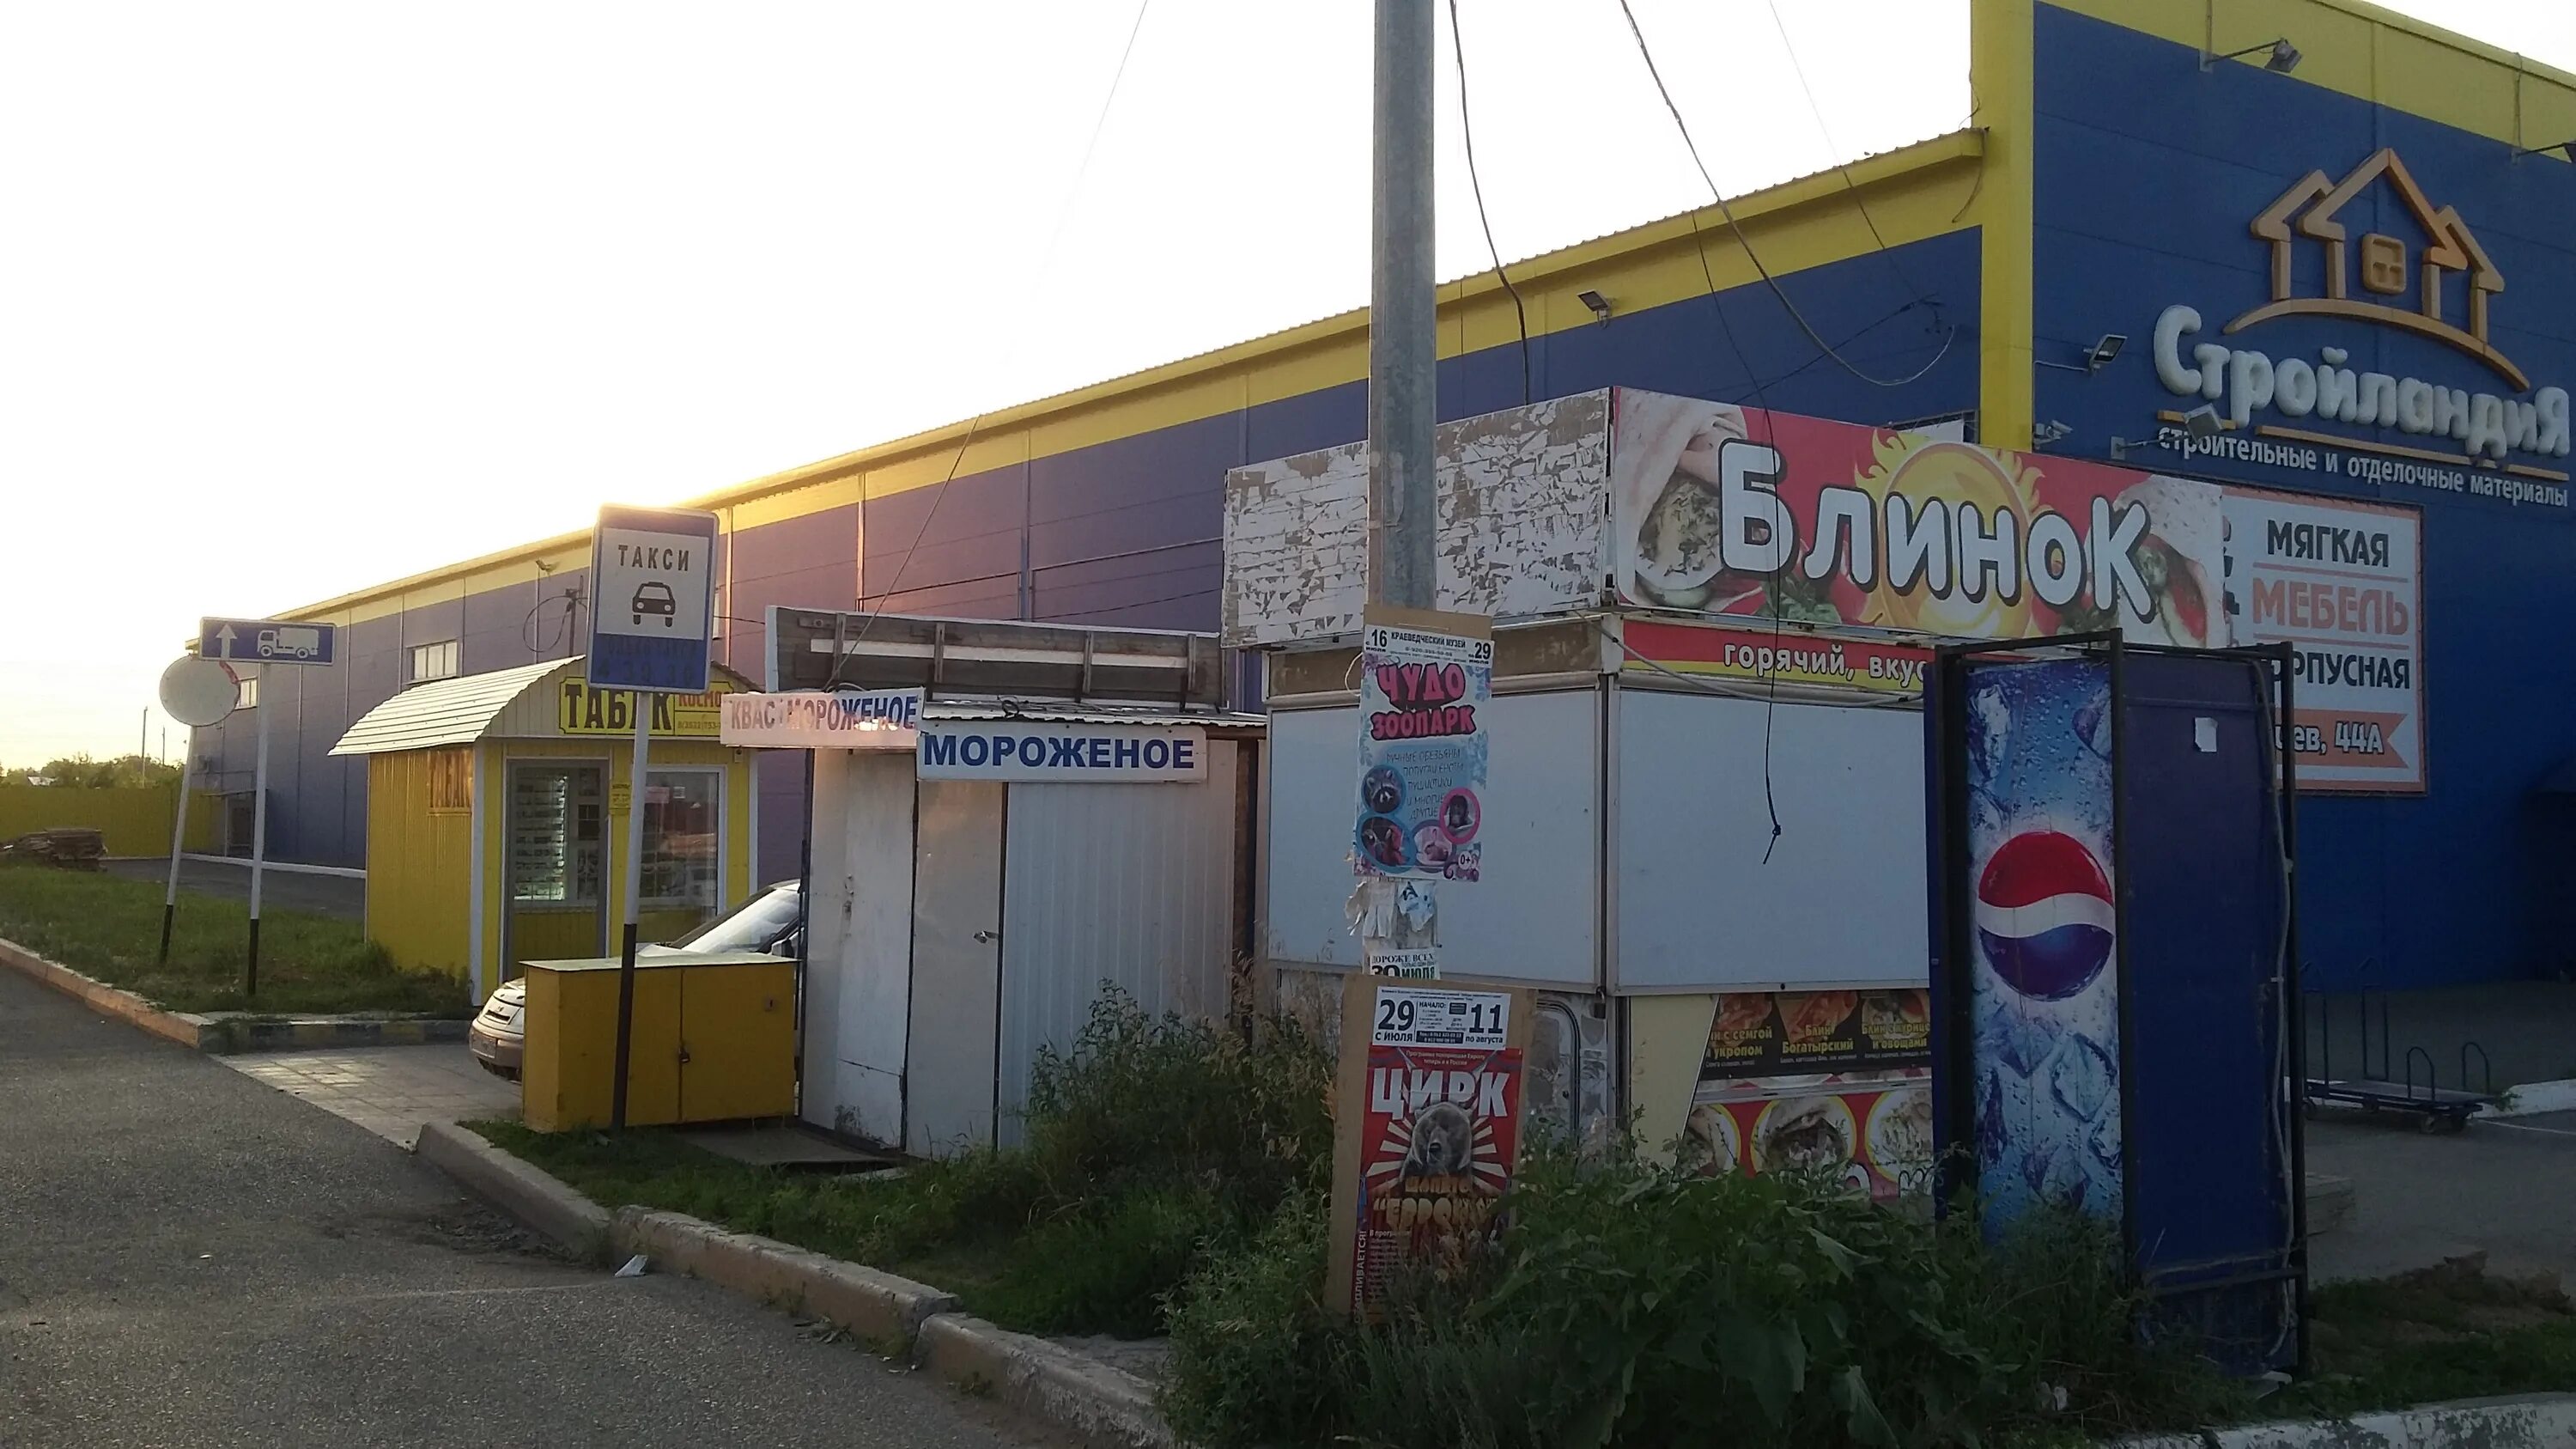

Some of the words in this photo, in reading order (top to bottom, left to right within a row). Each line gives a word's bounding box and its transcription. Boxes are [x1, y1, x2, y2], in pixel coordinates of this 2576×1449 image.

[2158, 426, 2318, 471] строительные
[2324, 452, 2339, 474] и
[2348, 456, 2464, 493] отделочные
[2470, 475, 2568, 508] материалы
[618, 545, 690, 572] ТАКСИ
[2267, 519, 2390, 568] МЯГКАЯ
[2252, 577, 2409, 636] МЕБЕЛЬ
[1371, 628, 1388, 648] 16
[1391, 631, 1446, 646] КРАЕВЕДЧЕСКИЙ
[1446, 638, 1467, 648] МУЗЕЙ
[1474, 642, 1492, 660] 29
[1723, 644, 1856, 681] горячий,
[1376, 662, 1466, 706] ЧУДО
[787, 694, 919, 731] МОРОЖЕНОЕ
[1370, 705, 1477, 740] ЗООПАРК
[923, 734, 1194, 770] МОРОЖЕНОЕ
[2335, 720, 2385, 756] 44А
[1460, 855, 1471, 865] 0+
[1378, 999, 1415, 1032] 29
[1469, 1003, 1504, 1034] 11
[1475, 1036, 1504, 1044] августа
[1714, 1045, 1764, 1059] укропом
[1782, 1038, 1854, 1054] Богатырский
[1880, 1038, 1928, 1050] овощами
[1371, 1067, 1511, 1120] ЦИРК
